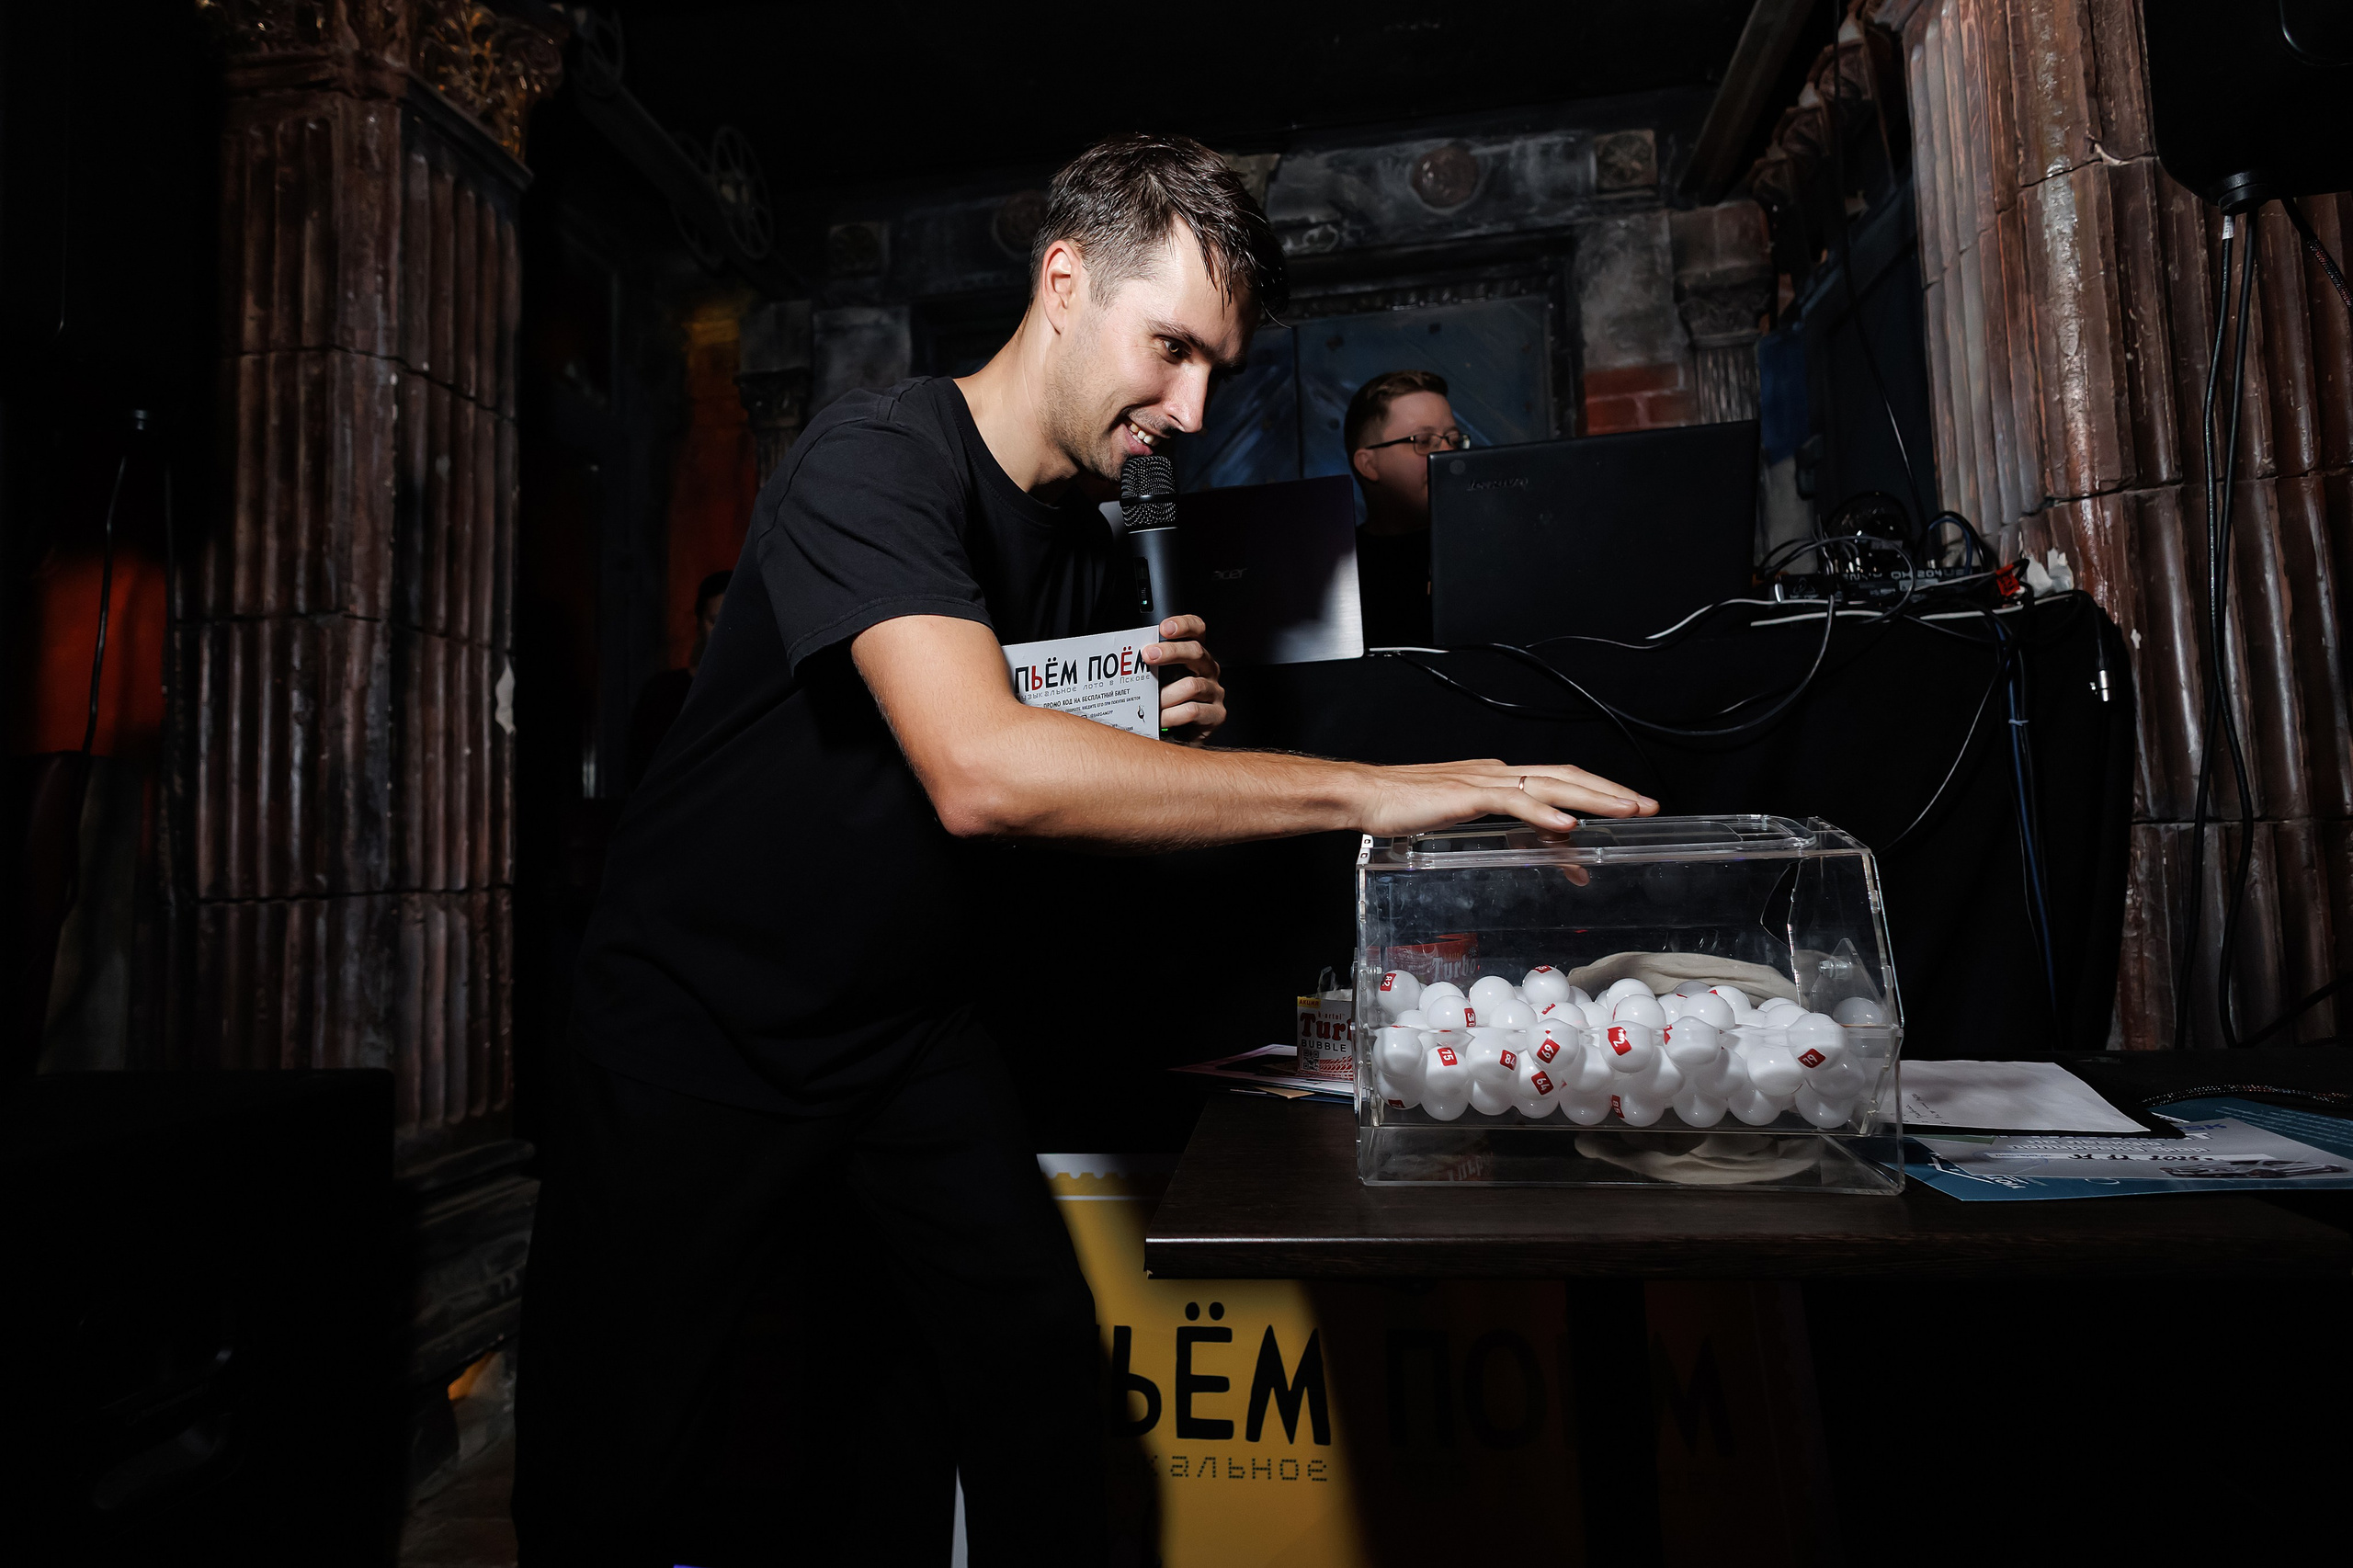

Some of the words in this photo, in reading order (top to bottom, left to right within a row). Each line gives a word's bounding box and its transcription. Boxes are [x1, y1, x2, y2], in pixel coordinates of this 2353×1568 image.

[1015, 656, 1078, 694] ПЬЁМ
[1087, 645, 1151, 682] ПОЁМ
[1020, 685, 1077, 702] узыкальное
[1301, 1039, 1347, 1052] BUBBLE
[1109, 1301, 1331, 1446] ЬЁМ
[1386, 1329, 1736, 1458] ПОМ
